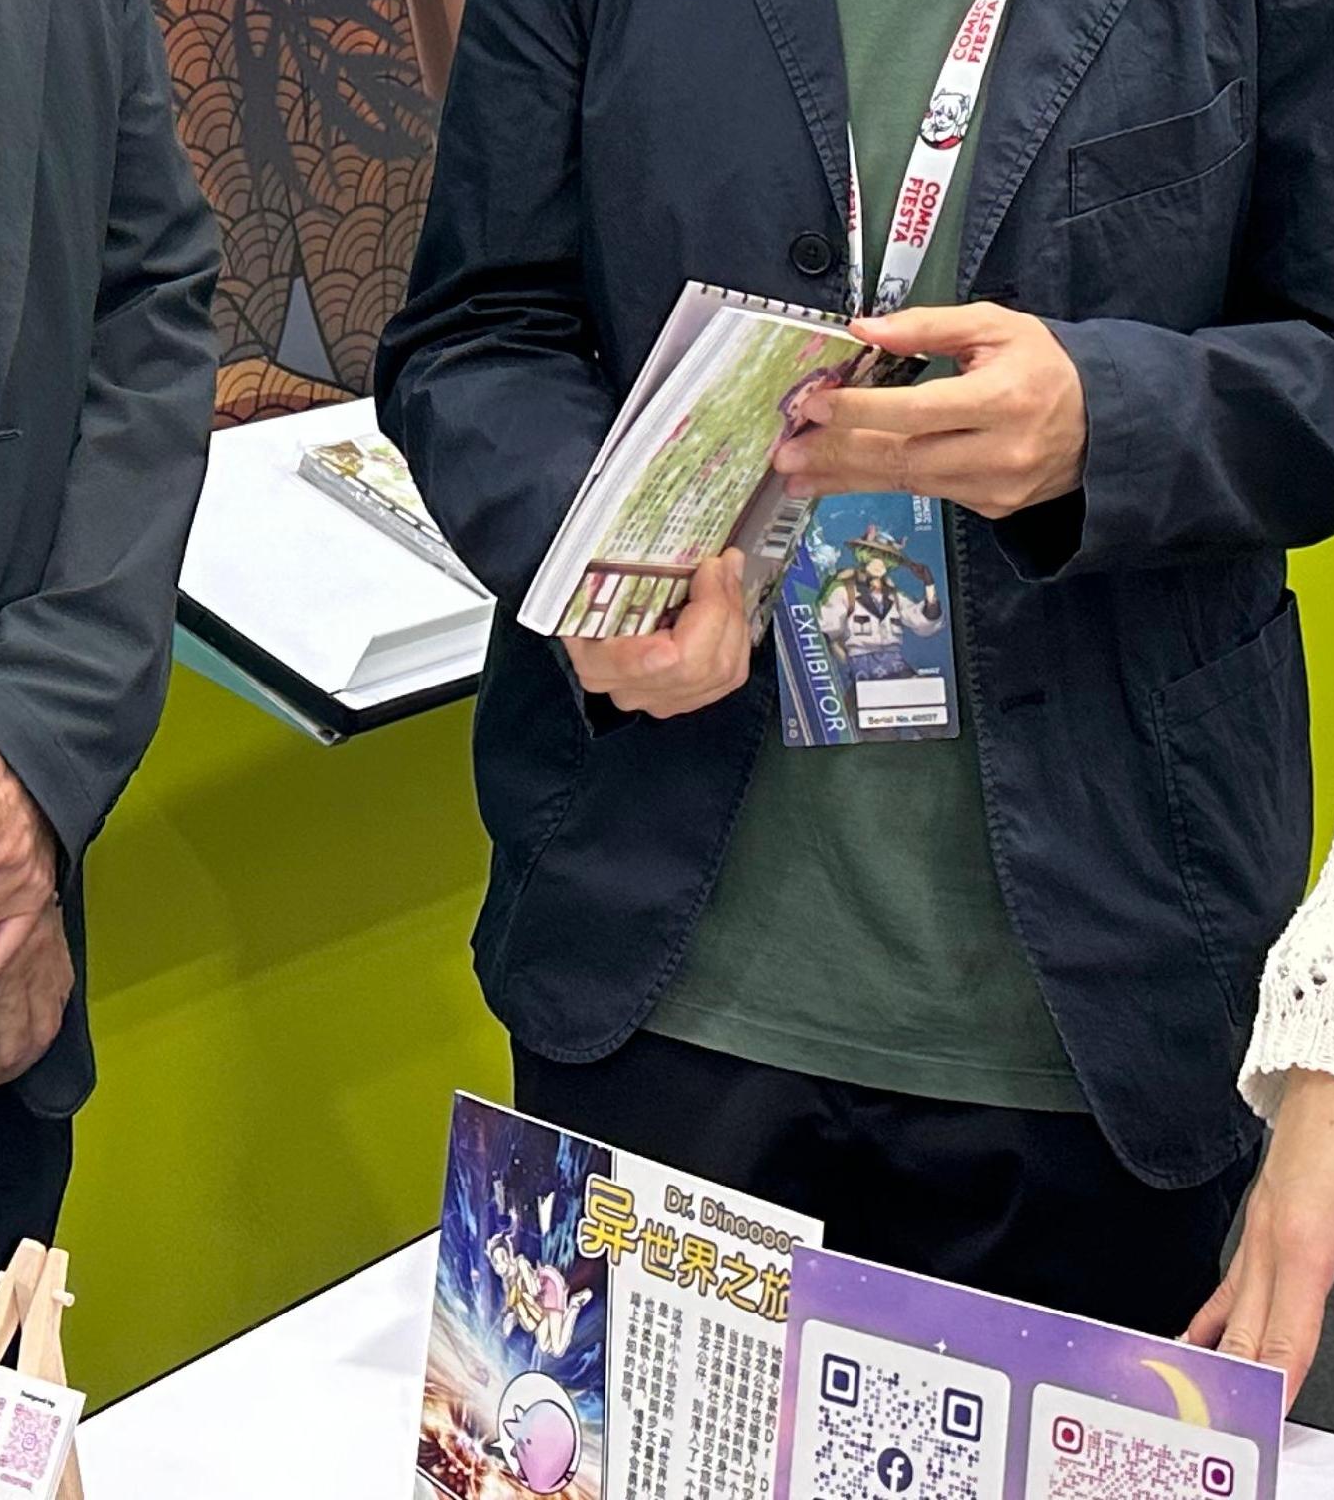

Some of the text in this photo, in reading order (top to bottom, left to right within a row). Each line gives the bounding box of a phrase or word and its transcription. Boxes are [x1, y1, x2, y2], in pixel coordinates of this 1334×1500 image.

[953, 0, 987, 61] COMIC
[968, 0, 999, 63] FIESTA
[892, 176, 924, 244] FIESTA
[910, 181, 941, 249] COMIC
[790, 603, 846, 733] EXHIBITOR
[665, 1184, 804, 1256] Dr. Dinoooo
